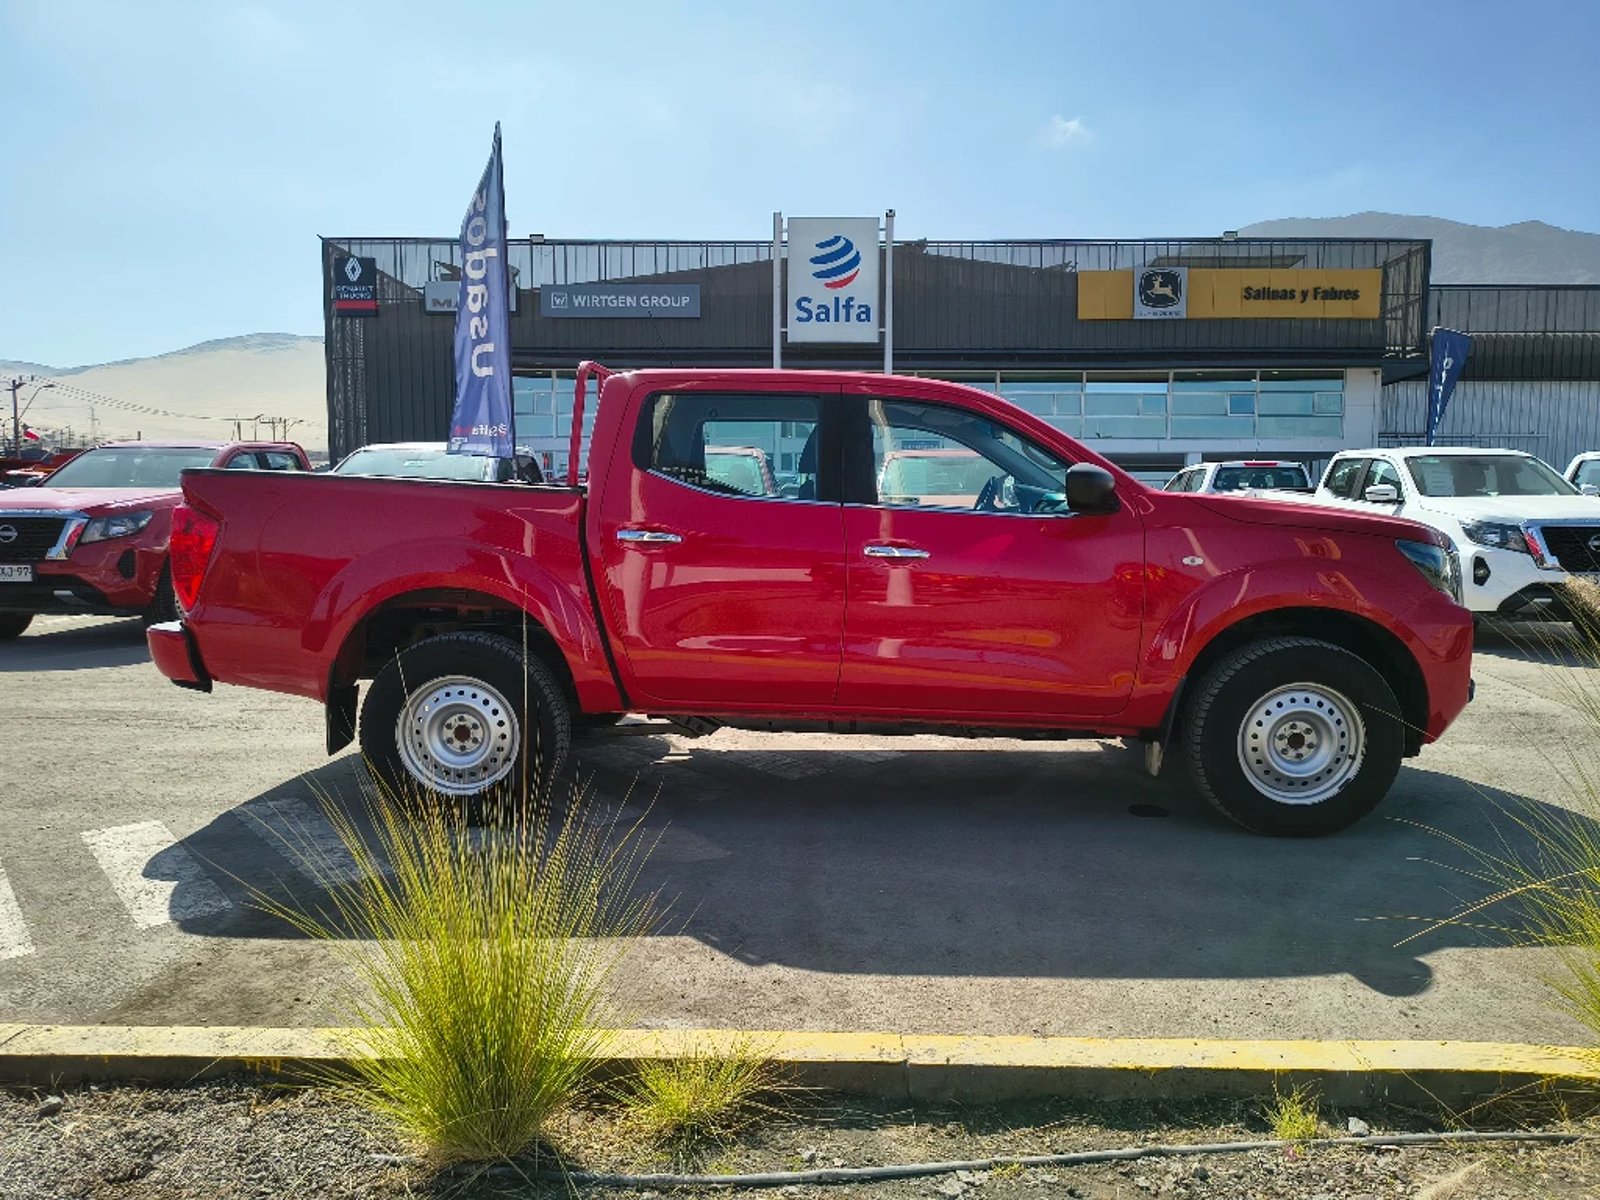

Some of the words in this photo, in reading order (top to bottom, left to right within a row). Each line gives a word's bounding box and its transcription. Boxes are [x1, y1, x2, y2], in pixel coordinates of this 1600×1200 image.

[572, 294, 637, 307] WIRTGEN
[639, 295, 690, 307] GROUP
[1243, 285, 1296, 301] Salinas
[1300, 289, 1309, 304] y
[1312, 286, 1360, 301] Fabres
[795, 296, 871, 323] Salfa
